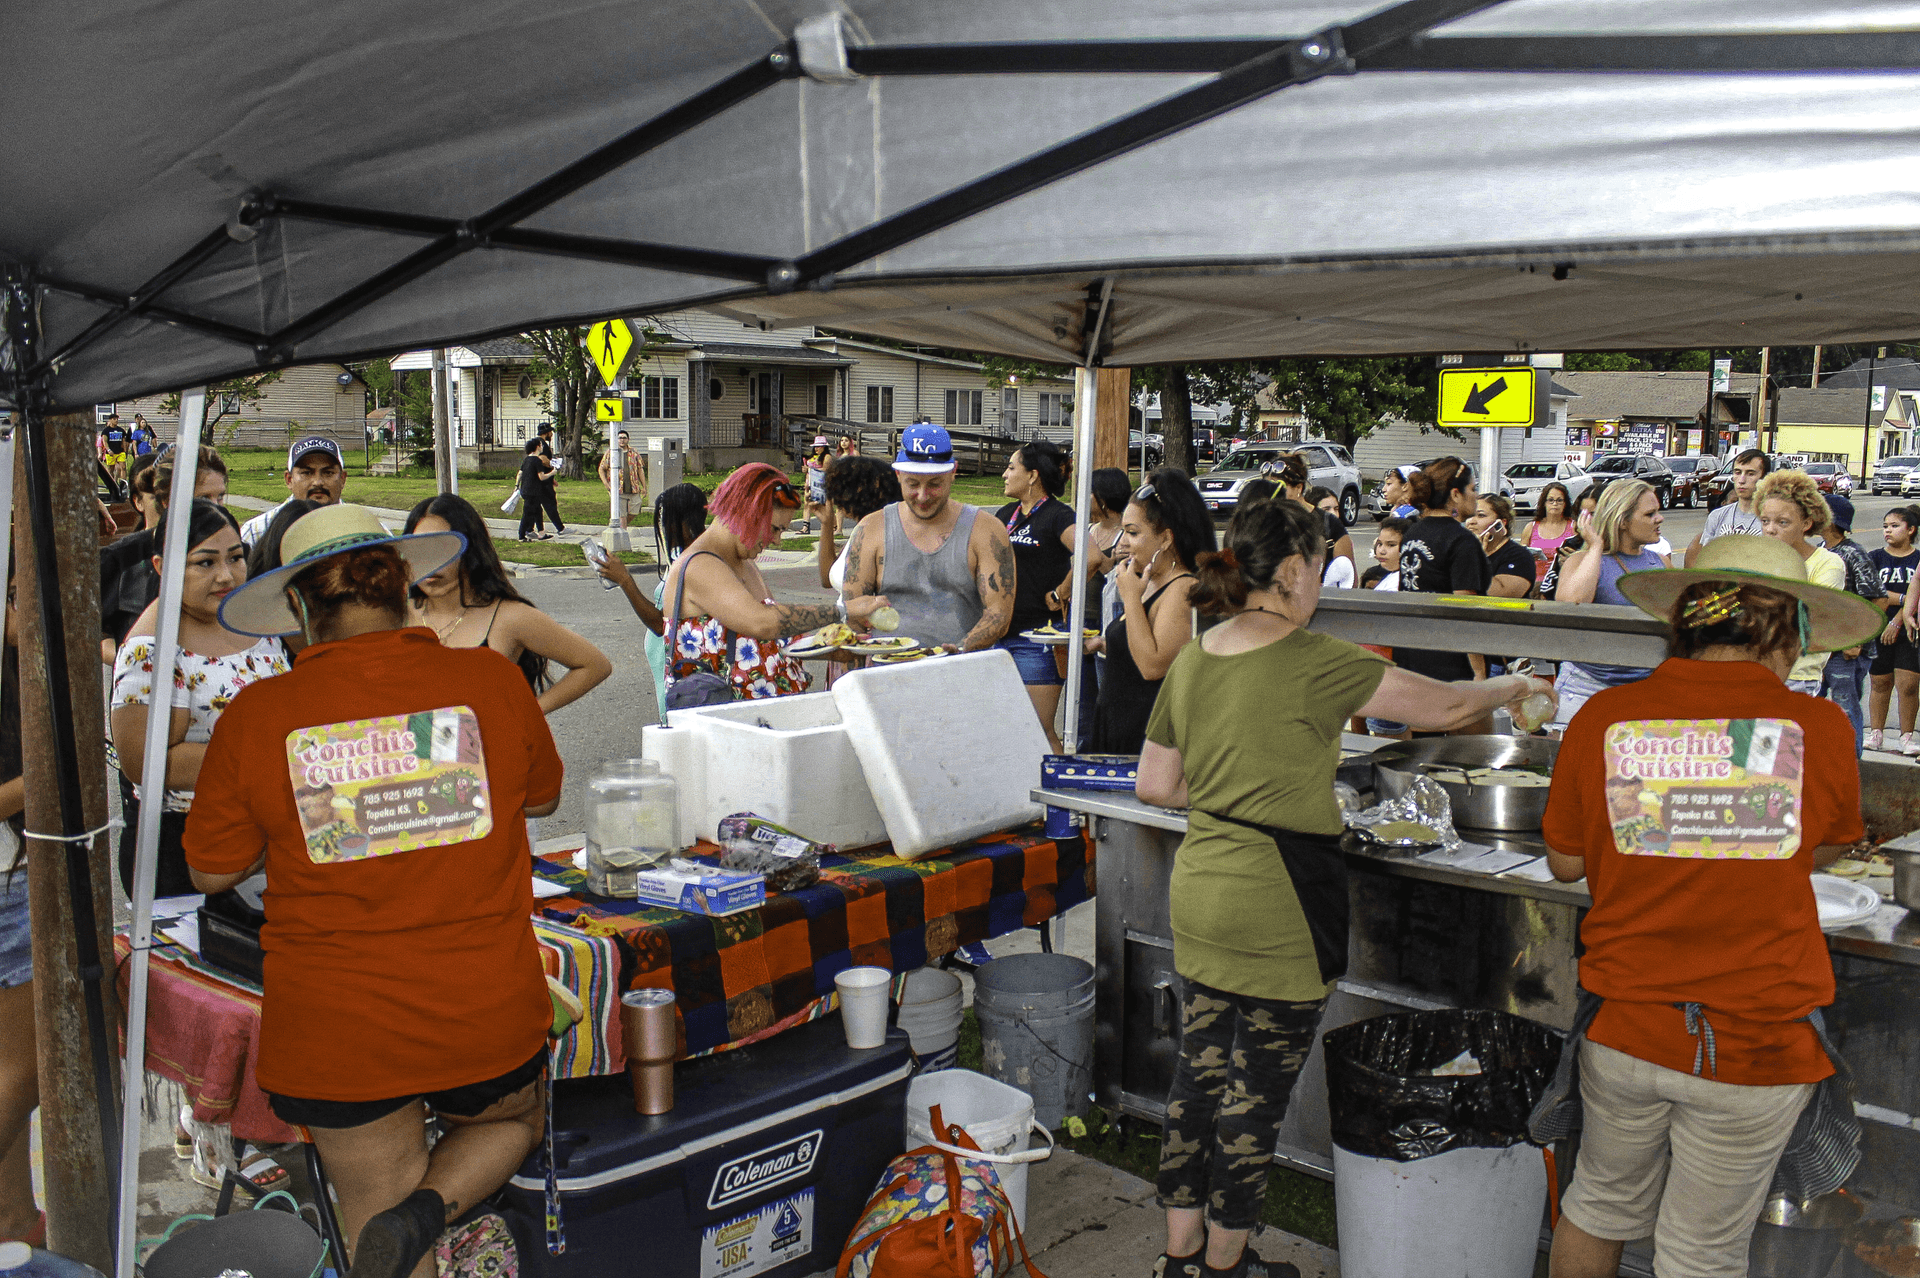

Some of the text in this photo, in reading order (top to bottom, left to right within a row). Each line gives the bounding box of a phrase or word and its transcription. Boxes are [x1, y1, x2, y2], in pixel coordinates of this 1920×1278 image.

[303, 730, 417, 763] Conchis
[1618, 732, 1732, 756] Conchis
[307, 755, 417, 786] Cuisine
[1620, 756, 1731, 779] Cuisine
[363, 787, 424, 805] 785 925 1692
[366, 808, 396, 821] Topeka
[367, 810, 477, 835] Conchiscuisine@gmail.com
[1671, 809, 1701, 822] Topeka
[651, 885, 667, 894] Gloves
[723, 1152, 796, 1191] Coleman
[784, 1208, 792, 1225] 5
[722, 1242, 748, 1268] USA
